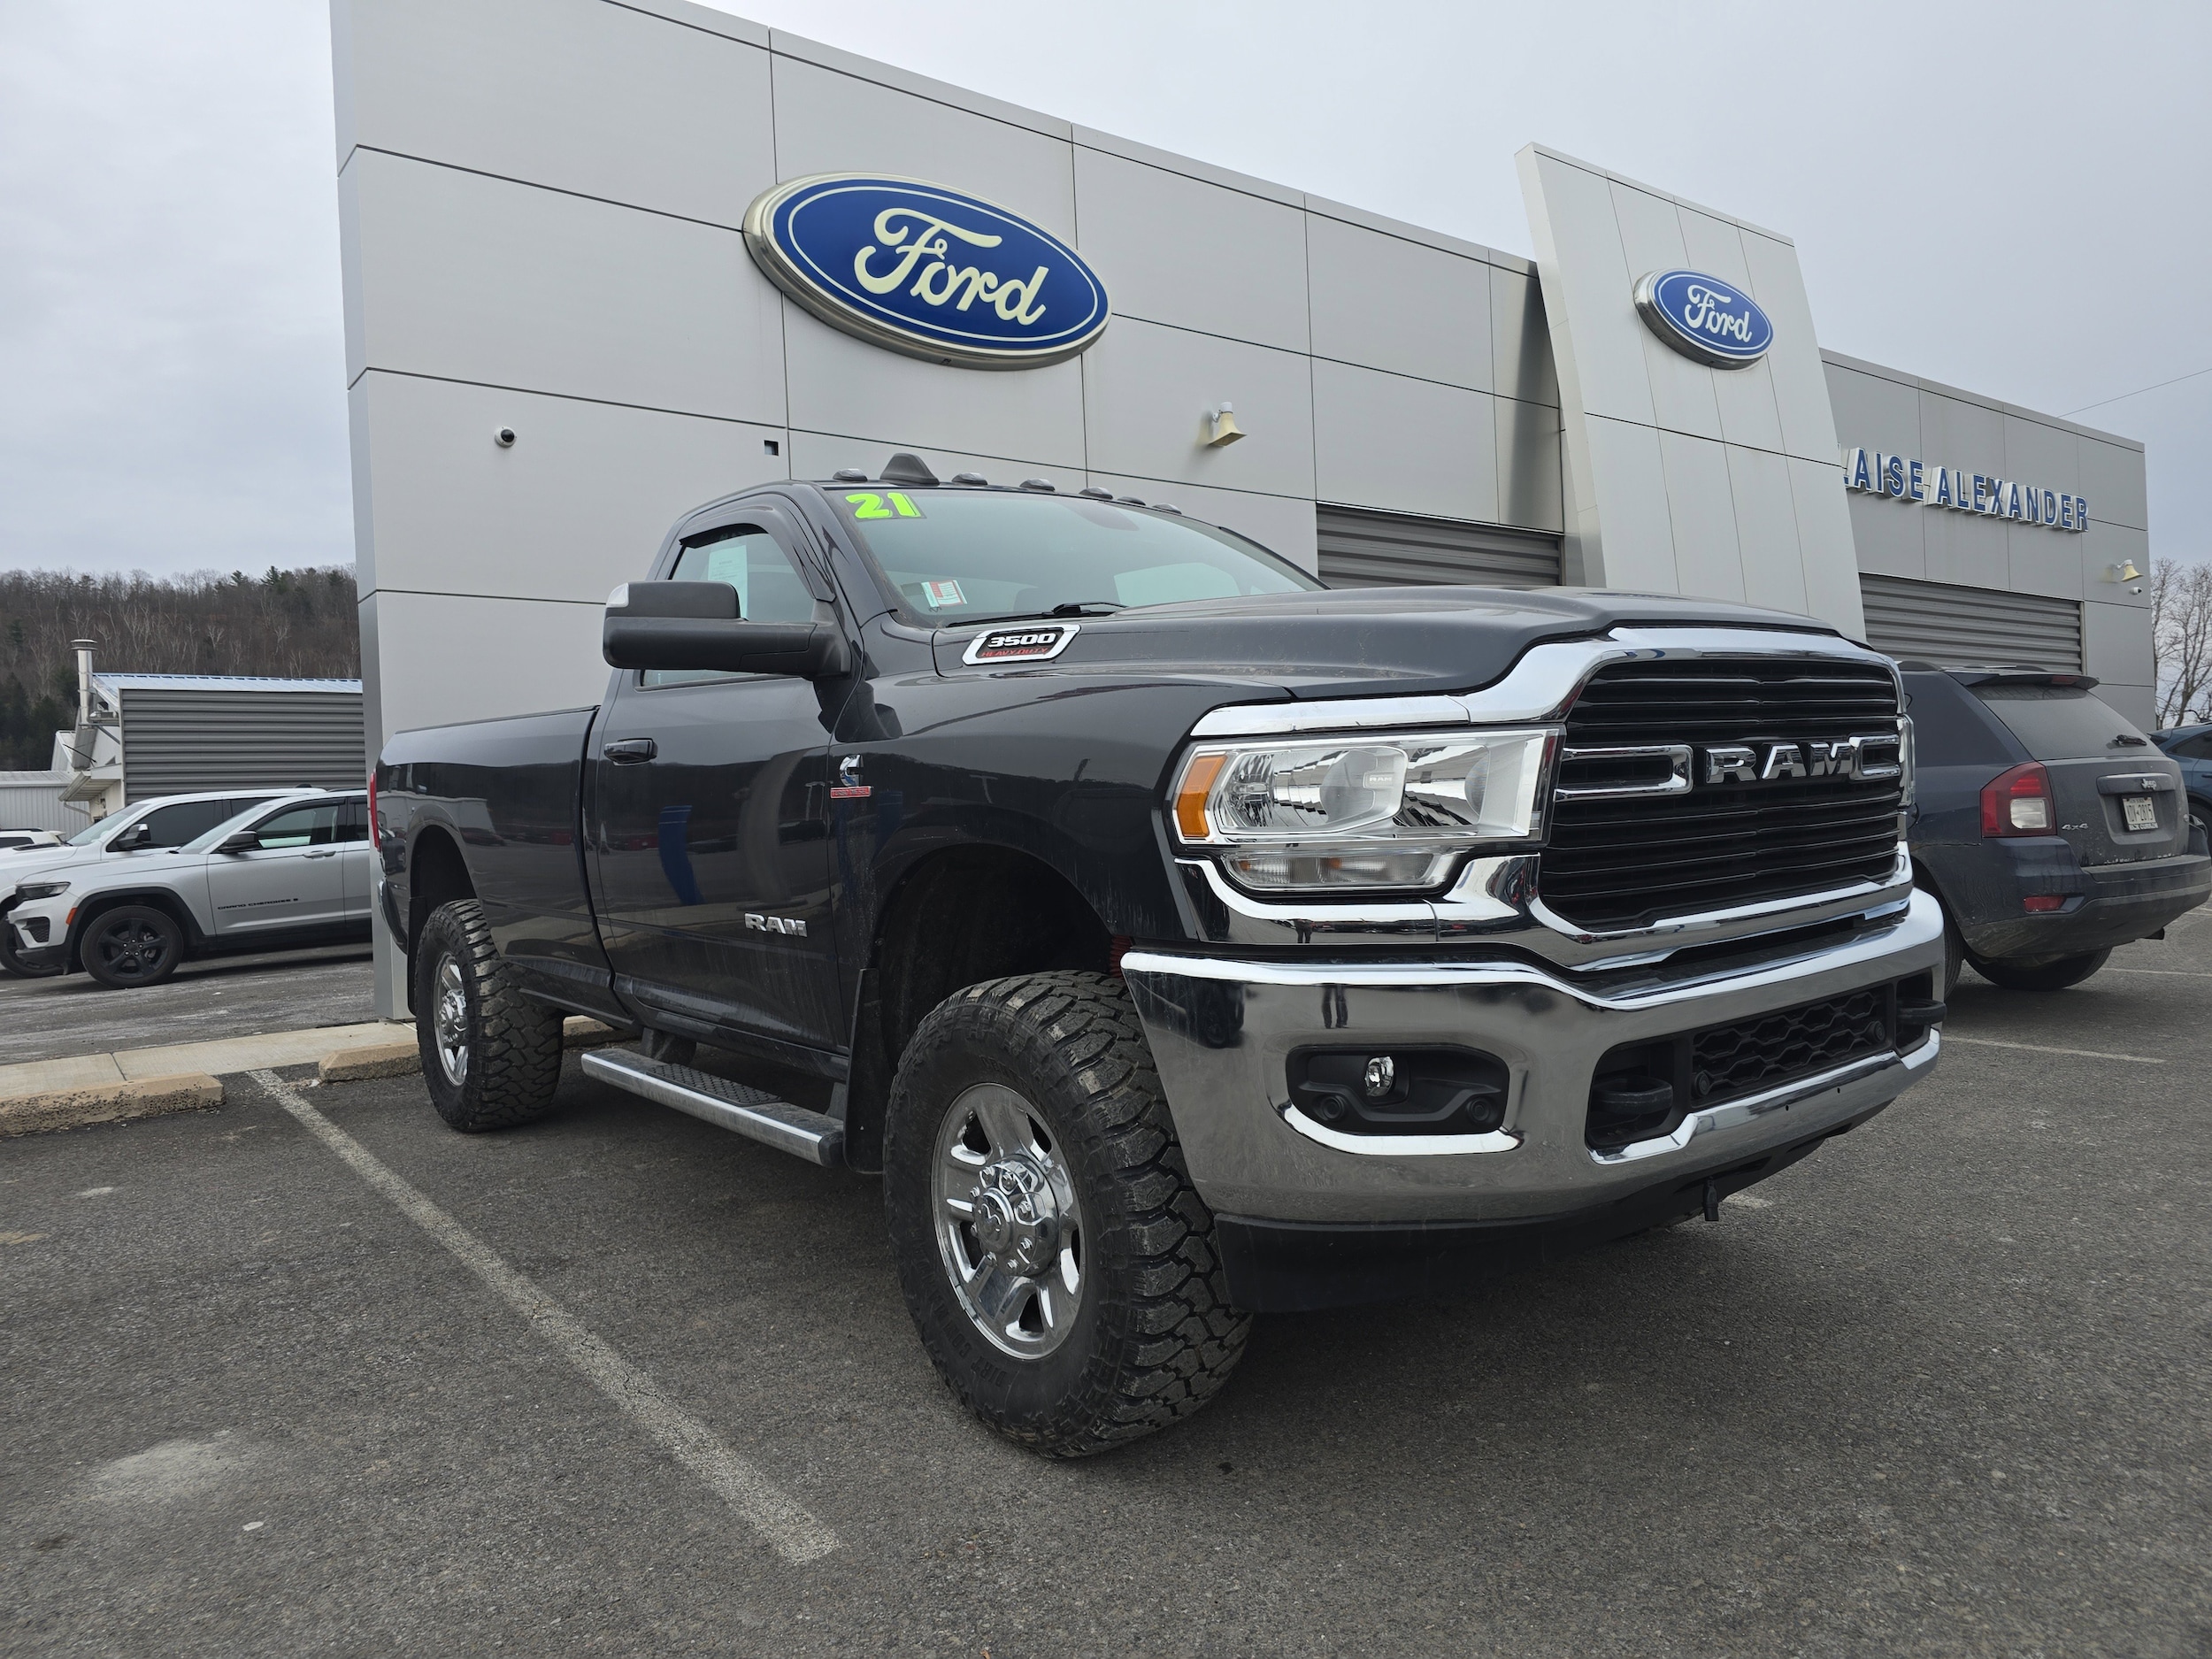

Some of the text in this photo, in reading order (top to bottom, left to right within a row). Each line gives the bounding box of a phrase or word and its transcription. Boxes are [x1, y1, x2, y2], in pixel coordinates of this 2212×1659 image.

[854, 208, 1049, 326] Ford
[1685, 284, 1752, 342] Ford
[1842, 447, 2089, 533] AISE ALEXANDER
[845, 492, 921, 519] 21
[981, 647, 1048, 657] HEAVY DUTY
[987, 633, 1056, 648] 3500
[1706, 742, 1855, 784] RAM
[2141, 778, 2157, 790] Jeep
[744, 913, 808, 938] RAM
